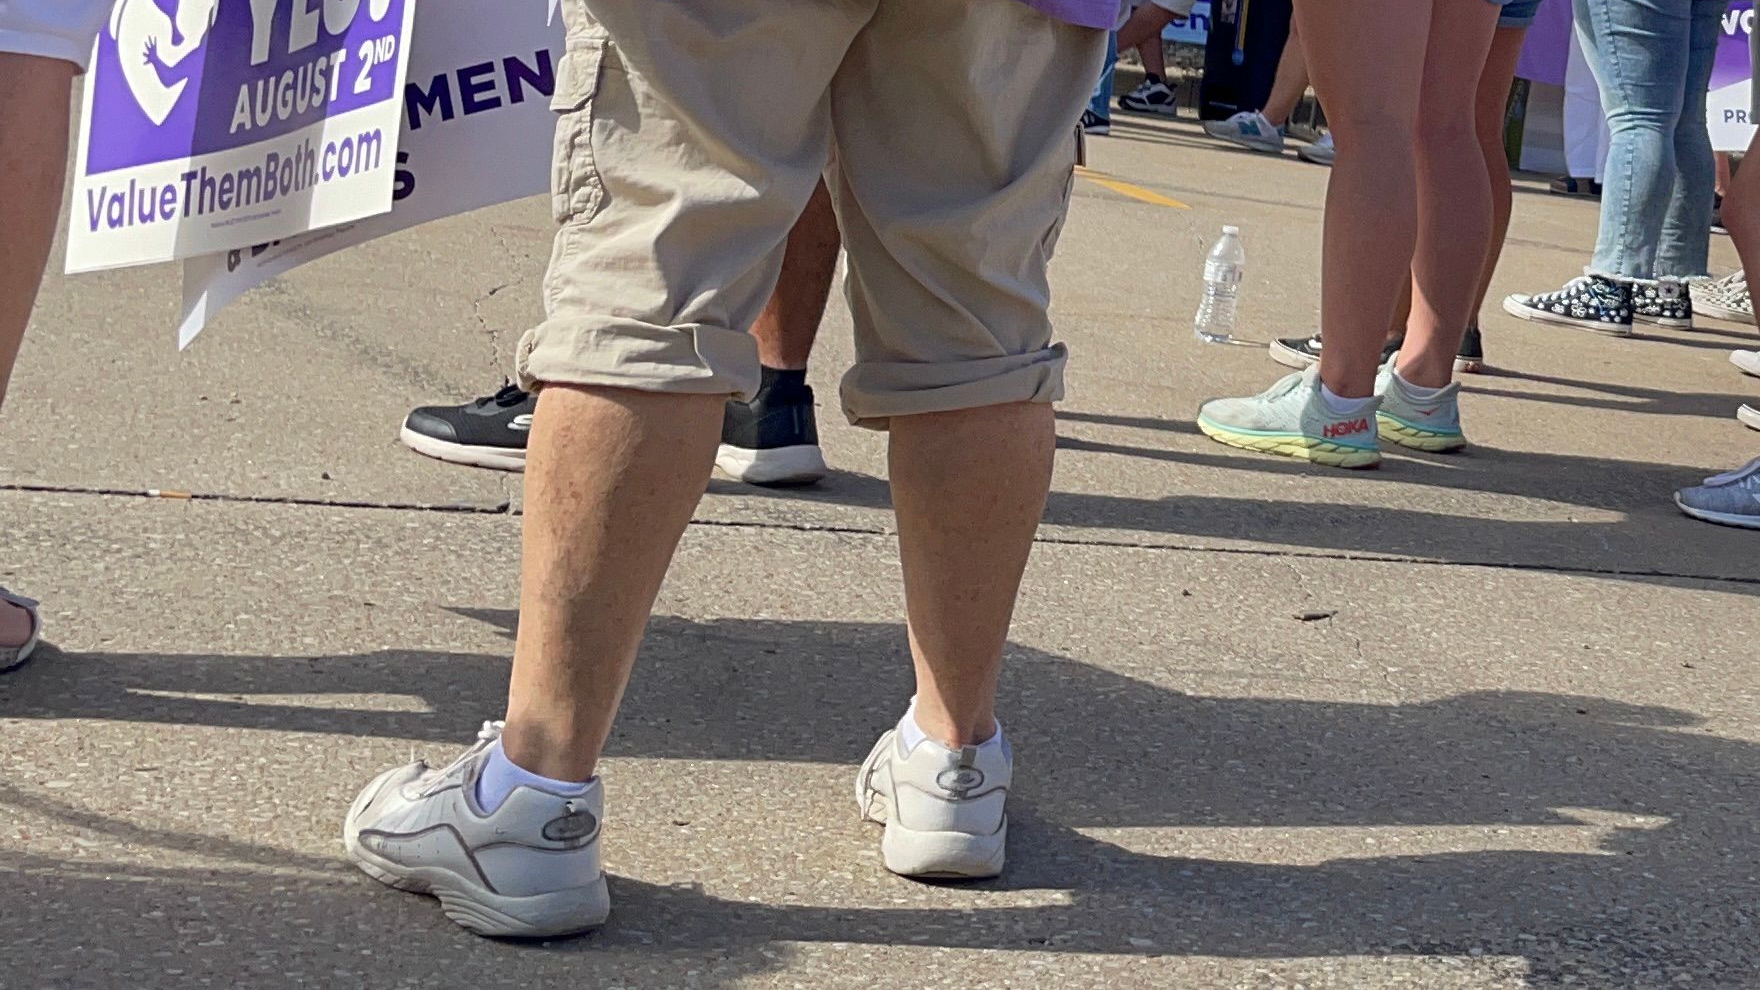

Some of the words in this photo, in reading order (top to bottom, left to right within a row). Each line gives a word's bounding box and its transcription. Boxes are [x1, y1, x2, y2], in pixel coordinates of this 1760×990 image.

[229, 48, 347, 134] AUGUST
[353, 34, 396, 94] 2ND
[87, 128, 382, 232] ValueThemBoth.com
[1323, 418, 1369, 437] HOKA
